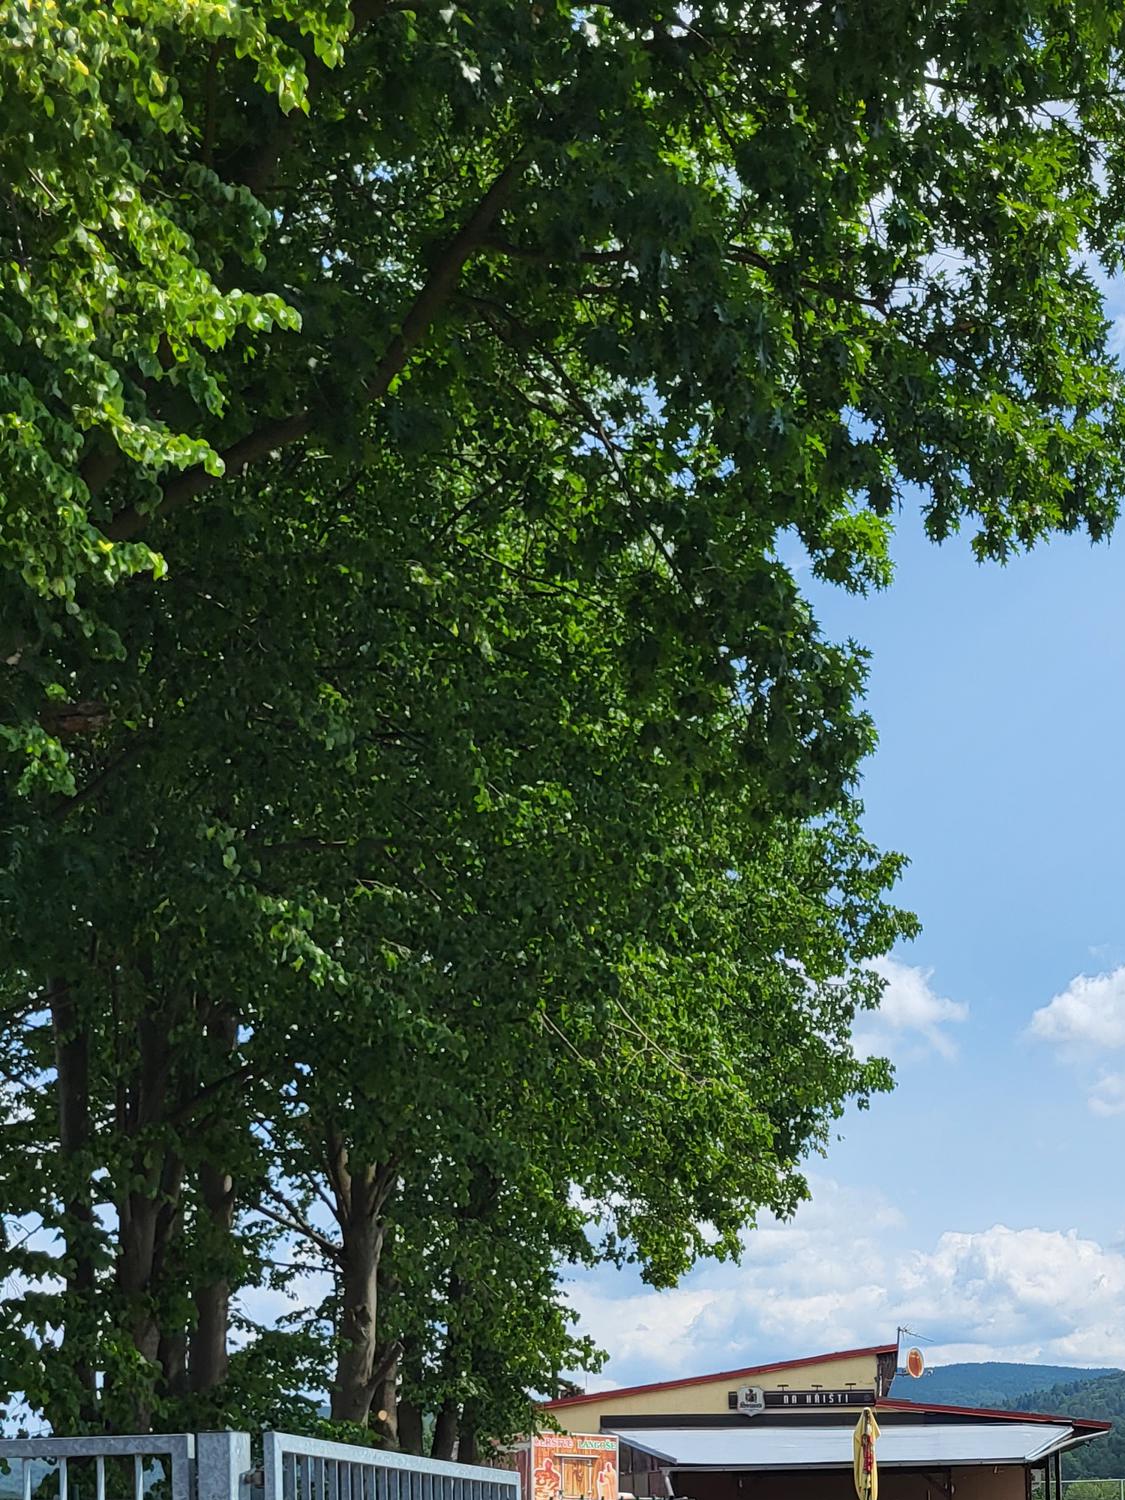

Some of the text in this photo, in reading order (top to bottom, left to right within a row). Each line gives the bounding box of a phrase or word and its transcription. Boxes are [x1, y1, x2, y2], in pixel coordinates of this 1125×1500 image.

[783, 1392, 849, 1404] NA HŘIŠTI
[577, 1438, 617, 1450] LANGOŠE
